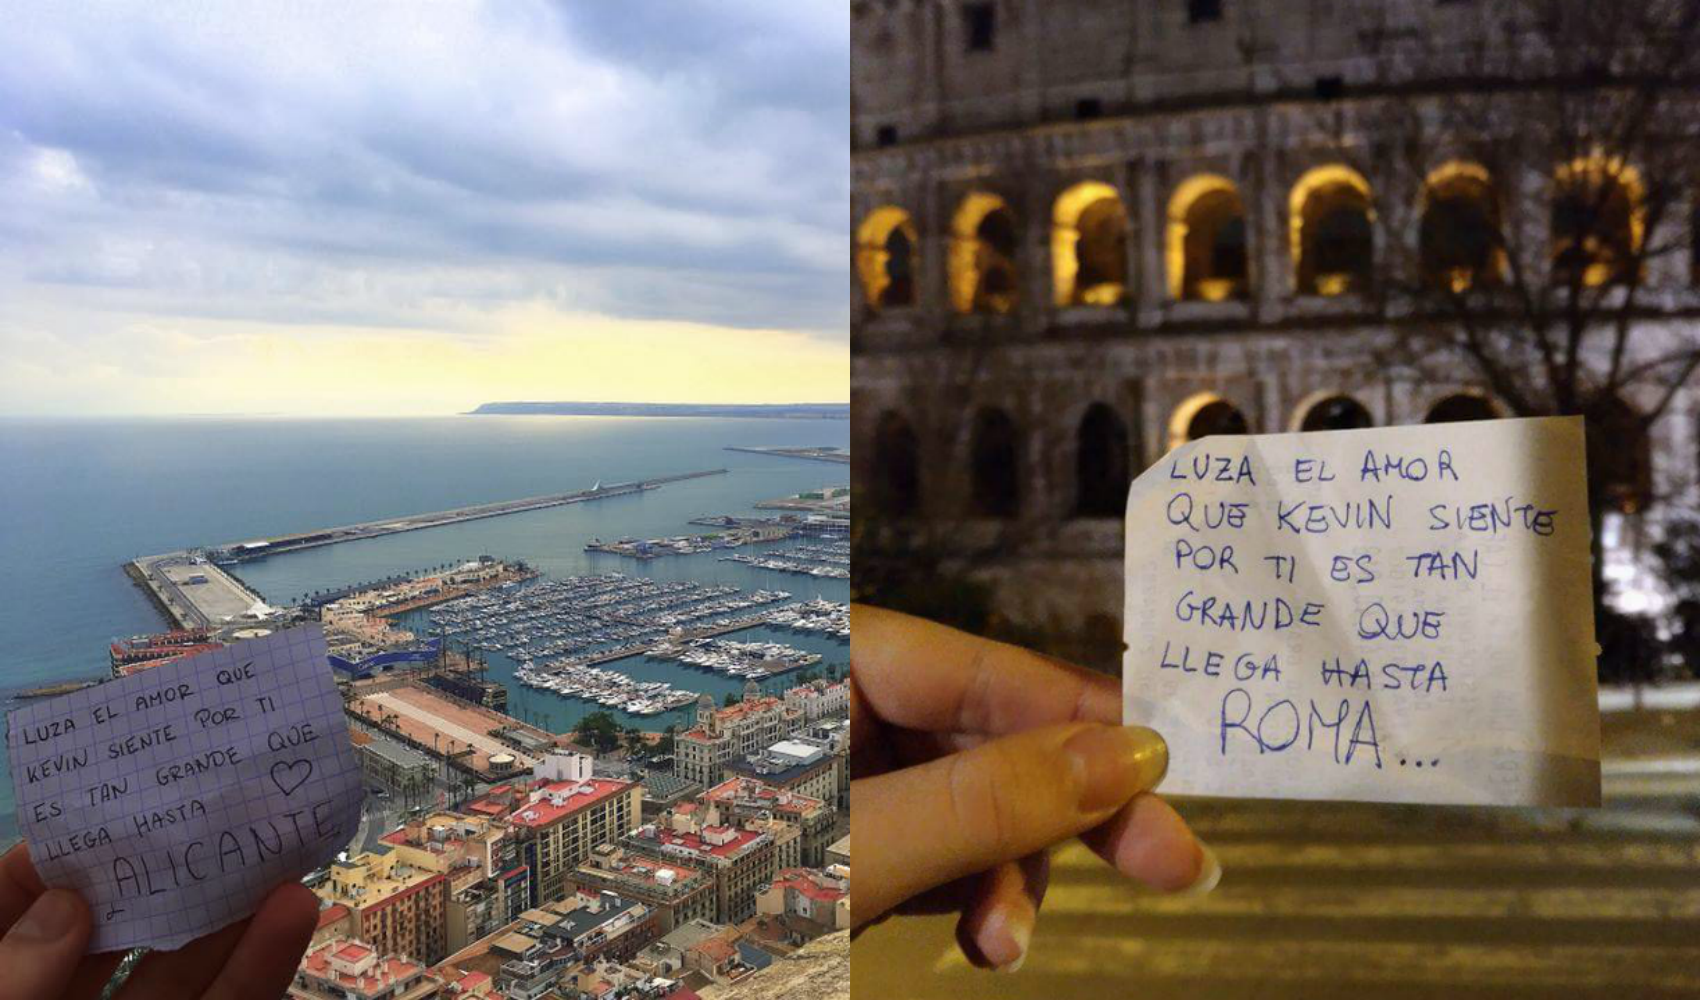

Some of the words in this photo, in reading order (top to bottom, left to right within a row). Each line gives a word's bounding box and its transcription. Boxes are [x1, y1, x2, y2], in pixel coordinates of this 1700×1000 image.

[1170, 453, 1257, 487] LUZA
[1295, 457, 1336, 483] EL
[1360, 449, 1460, 483] AMOR
[1166, 492, 1250, 532] QUE
[1277, 494, 1393, 535] KEVIN
[1428, 496, 1561, 537] SIENTE
[1175, 539, 1239, 575] POR
[1263, 554, 1296, 584] TI
[1330, 554, 1377, 584] ES
[1406, 549, 1479, 581] TAN
[1175, 590, 1326, 632] GRANDE
[1357, 602, 1446, 641] QUE
[1160, 641, 1283, 683] LLEGA
[1320, 658, 1449, 693] HASTA
[23, 718, 76, 745] LUZA
[93, 705, 118, 725] EL
[135, 683, 195, 712] AMOR
[216, 662, 257, 685] QUE
[26, 750, 88, 784] KEVIN
[108, 725, 177, 759] SIENTE
[194, 707, 240, 728] POR
[255, 696, 275, 713] TI
[33, 802, 61, 824] ES
[88, 778, 129, 807] TAN
[155, 747, 244, 786] GRANDE
[267, 724, 320, 752] QUE
[45, 827, 112, 861] LLEGA
[133, 800, 207, 838] HASTA
[112, 800, 341, 898] ALICANTE
